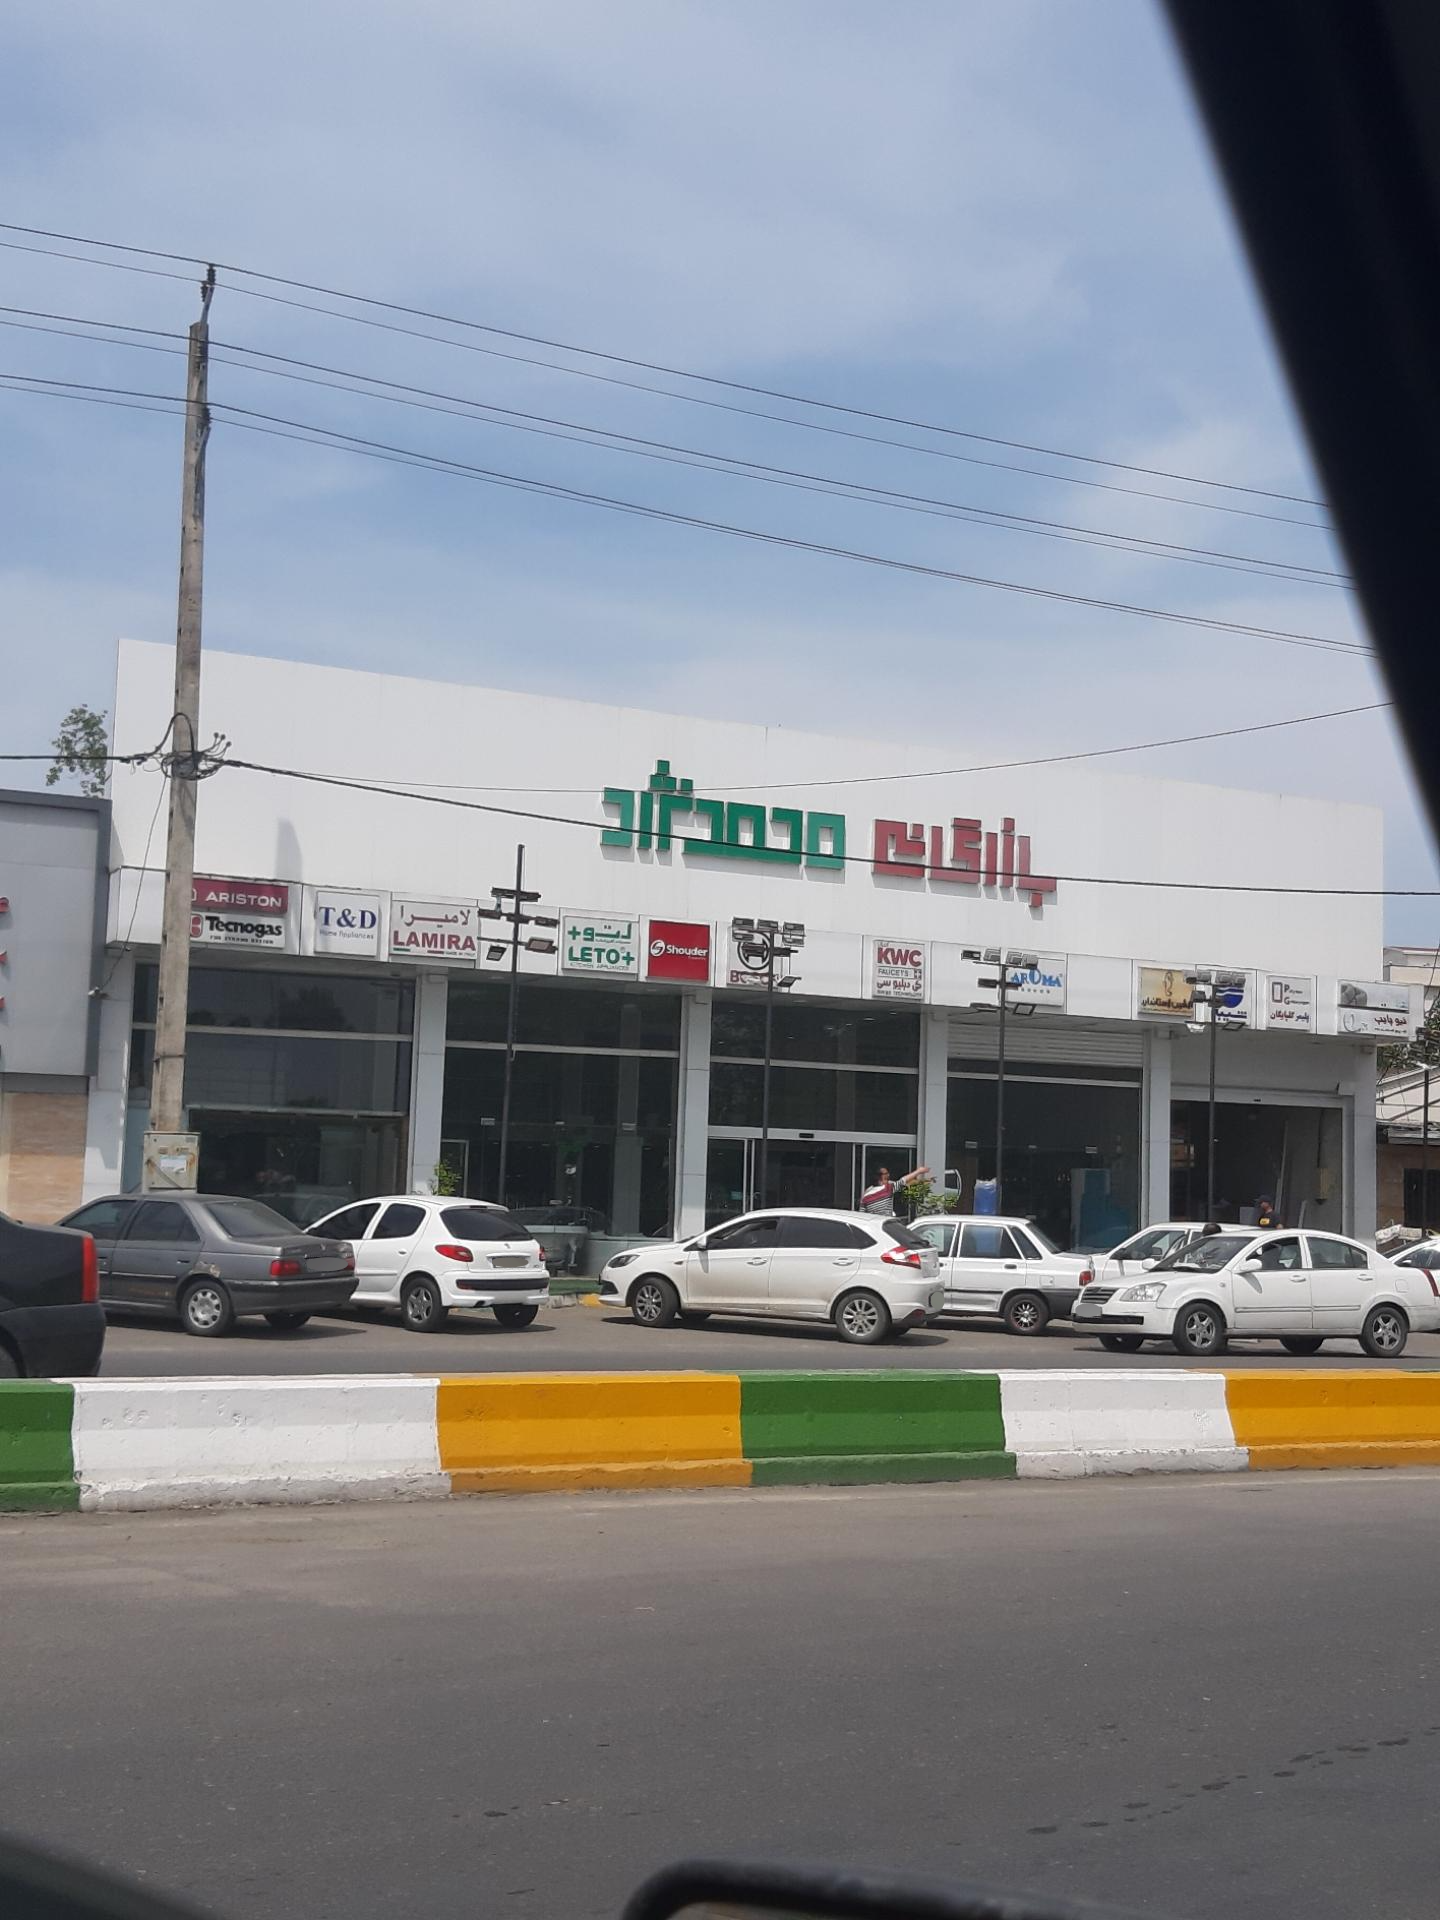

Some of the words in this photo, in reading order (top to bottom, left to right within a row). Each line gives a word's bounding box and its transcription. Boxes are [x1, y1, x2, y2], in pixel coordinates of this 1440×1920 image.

[205, 891, 283, 908] ARISTON
[205, 915, 284, 939] Tecnogas
[318, 906, 377, 930] T&D
[400, 904, 471, 929] لامیرا
[392, 930, 477, 952] LAMIRA
[665, 944, 708, 957] Shouder
[876, 947, 922, 967] KWC
[1009, 967, 1063, 988] AROMA
